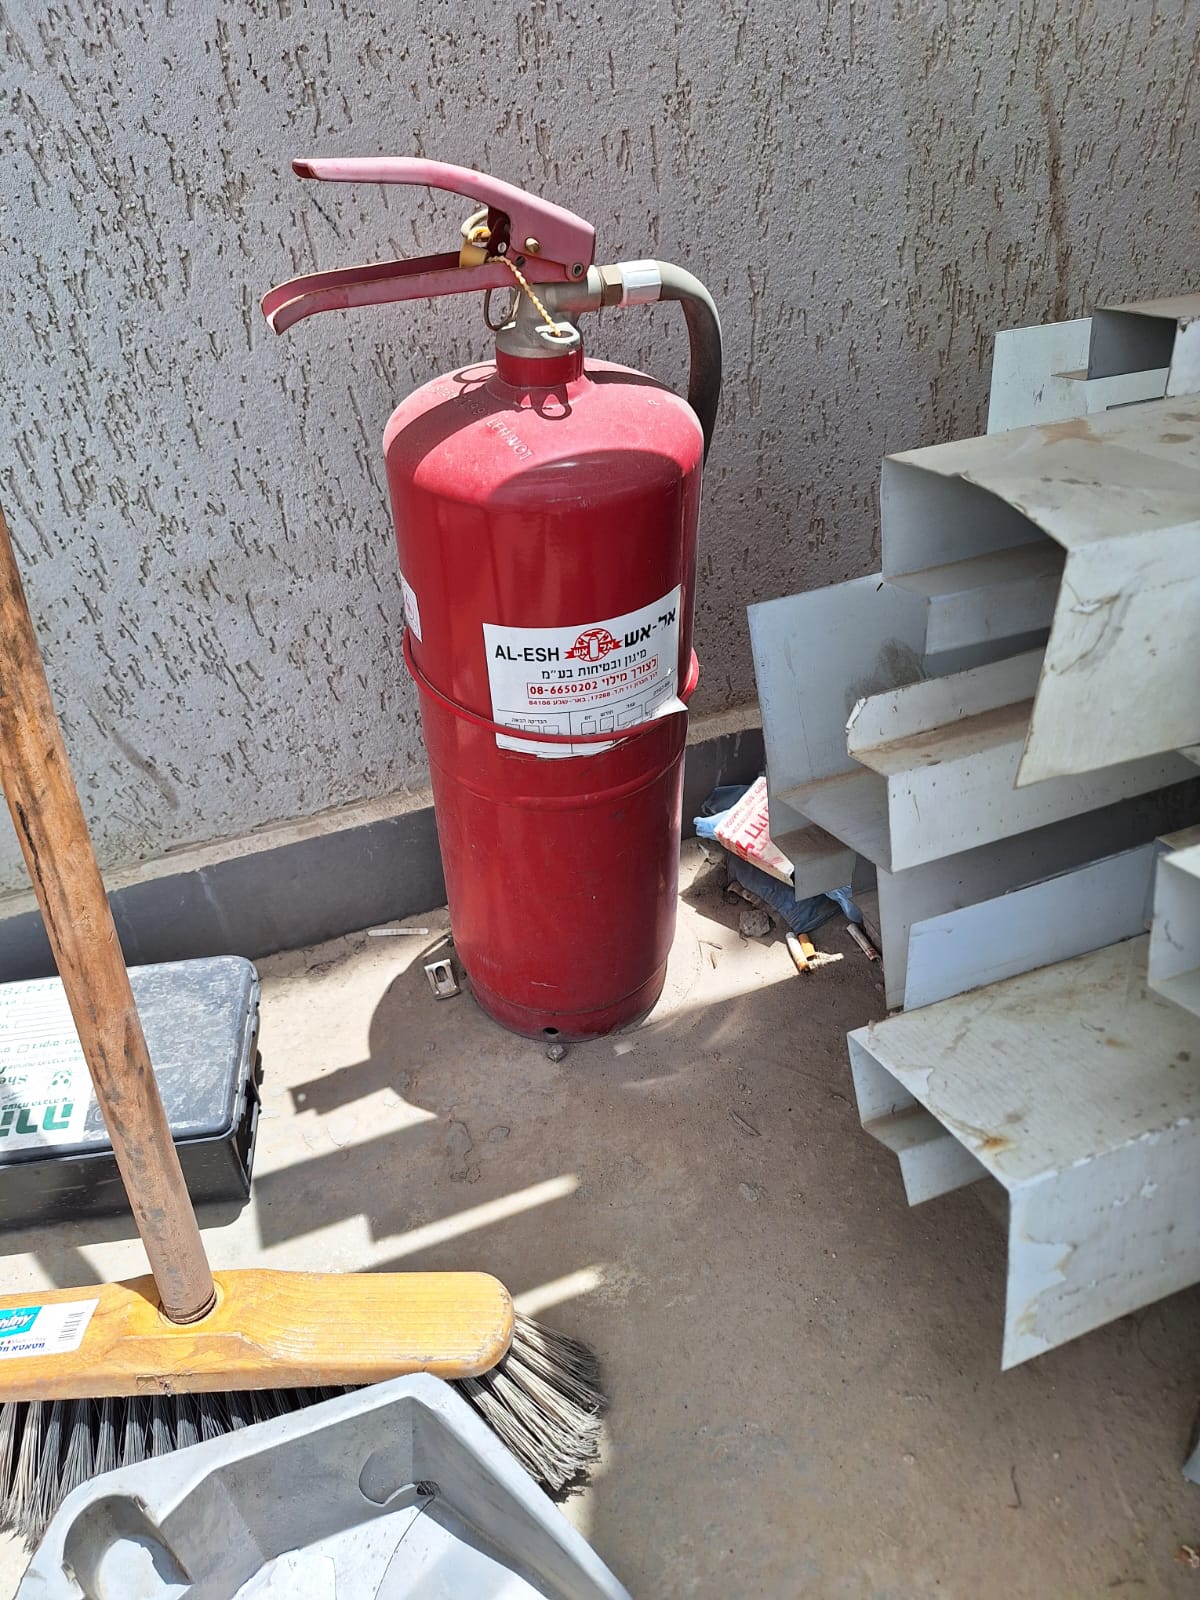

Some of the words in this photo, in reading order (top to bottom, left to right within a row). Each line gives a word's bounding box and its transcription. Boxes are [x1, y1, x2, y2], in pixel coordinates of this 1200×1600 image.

[495, 644, 560, 662] AL-ESH
[624, 649, 647, 667] מיגון
[577, 661, 621, 677] ובטיחות
[630, 659, 657, 679] לצורך
[601, 672, 627, 686] מילוי
[530, 681, 598, 695] 08-6650202
